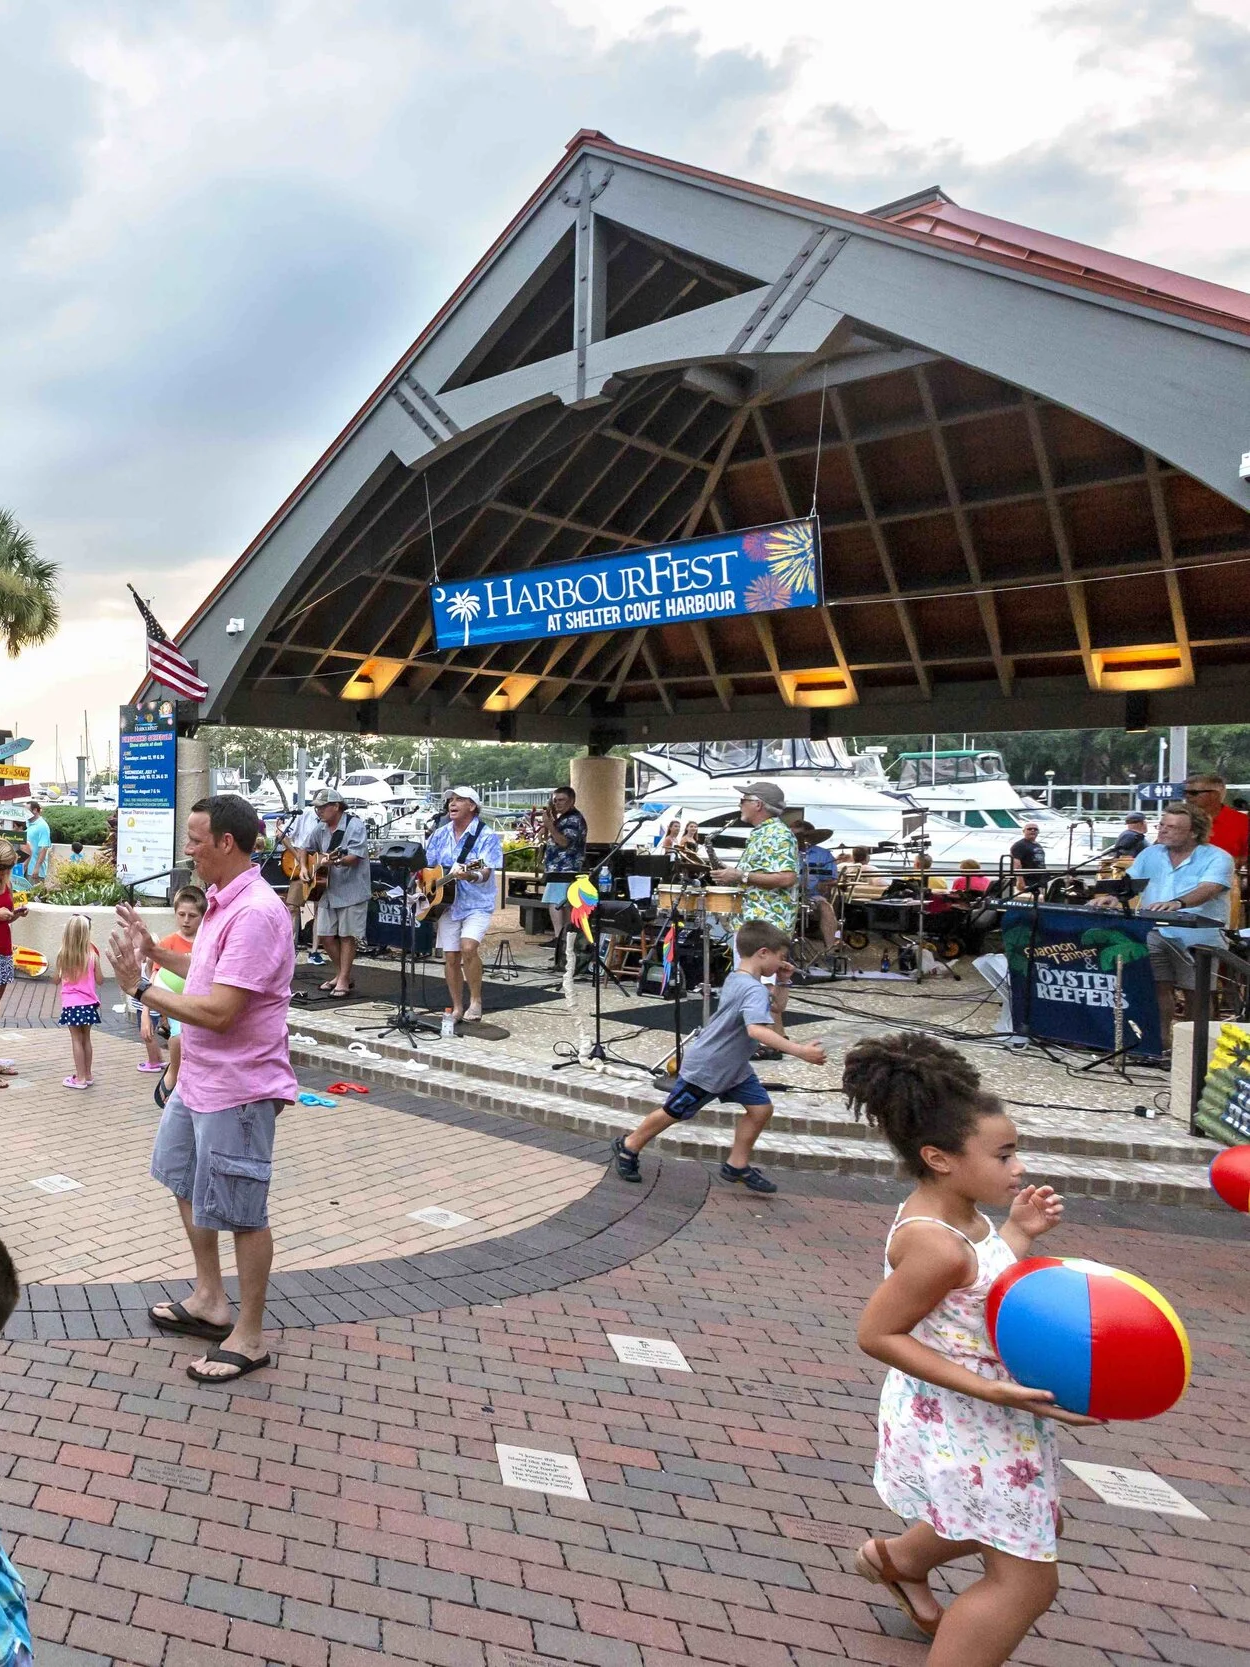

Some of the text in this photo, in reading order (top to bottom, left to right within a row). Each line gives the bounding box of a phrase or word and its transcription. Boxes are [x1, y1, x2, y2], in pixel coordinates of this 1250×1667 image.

[547, 590, 736, 632] AT SHELTER COVE HARBOUR
[13, 768, 29, 777] SAND
[1024, 942, 1077, 959] Sannon
[1048, 947, 1098, 965] Tanner
[1085, 958, 1099, 971] &
[1038, 969, 1118, 992] OYSTER
[1037, 984, 1129, 1009] REEFERS
[548, 1472, 571, 1480] Family
[550, 1477, 573, 1485] Family
[549, 1482, 572, 1490] Family
